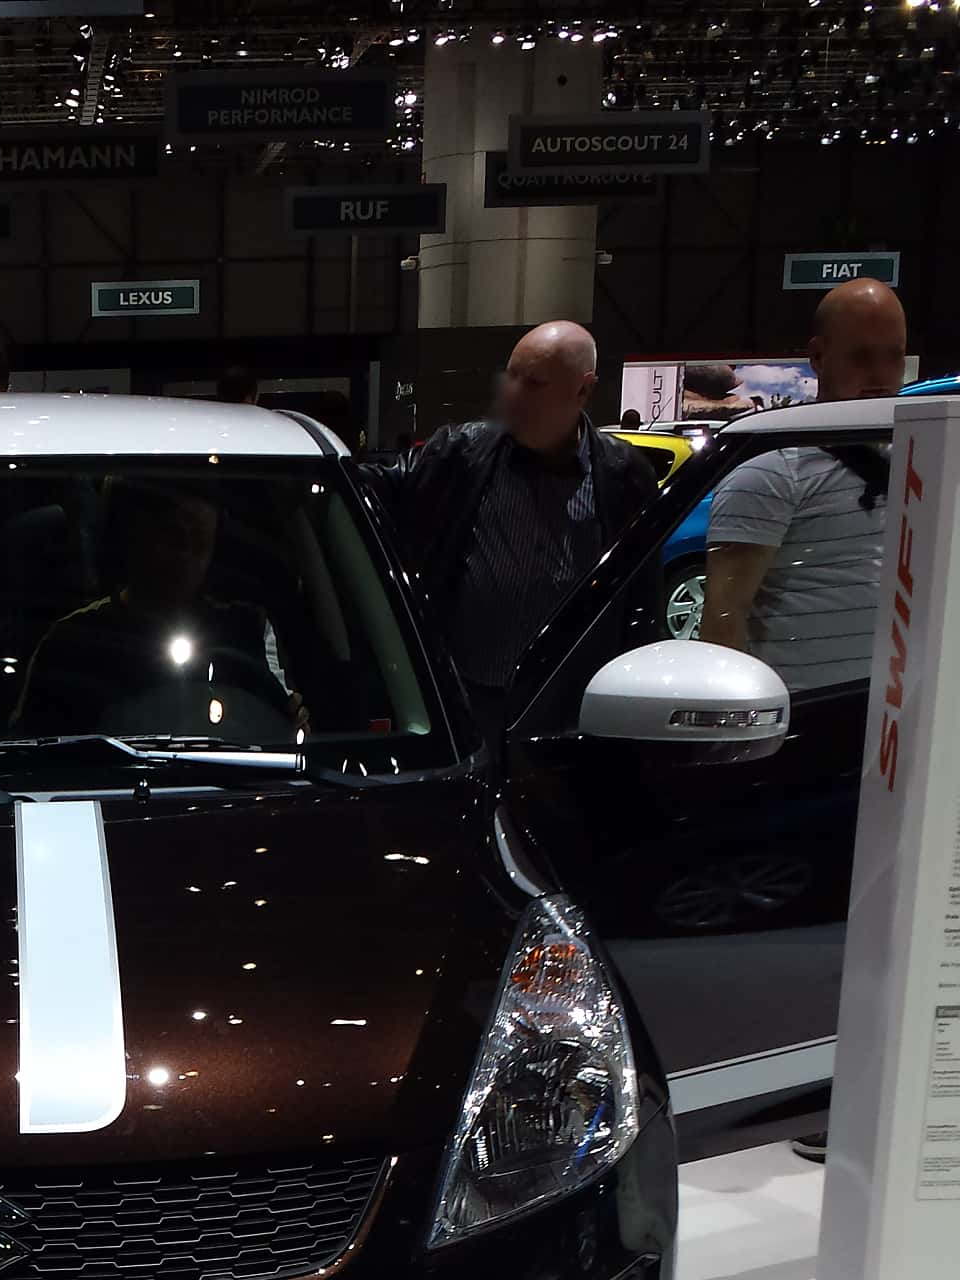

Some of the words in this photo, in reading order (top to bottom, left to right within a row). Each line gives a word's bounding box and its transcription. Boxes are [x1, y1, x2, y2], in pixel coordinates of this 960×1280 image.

[240, 88, 319, 106] NIMROD
[207, 106, 352, 127] PERFORMANCE
[531, 136, 662, 154] AUTOSCOUT
[667, 134, 689, 151] 24
[339, 200, 389, 222] RUF
[822, 263, 862, 279] FIAT
[119, 291, 172, 307] LEXUS
[879, 434, 923, 793] SWIFT
